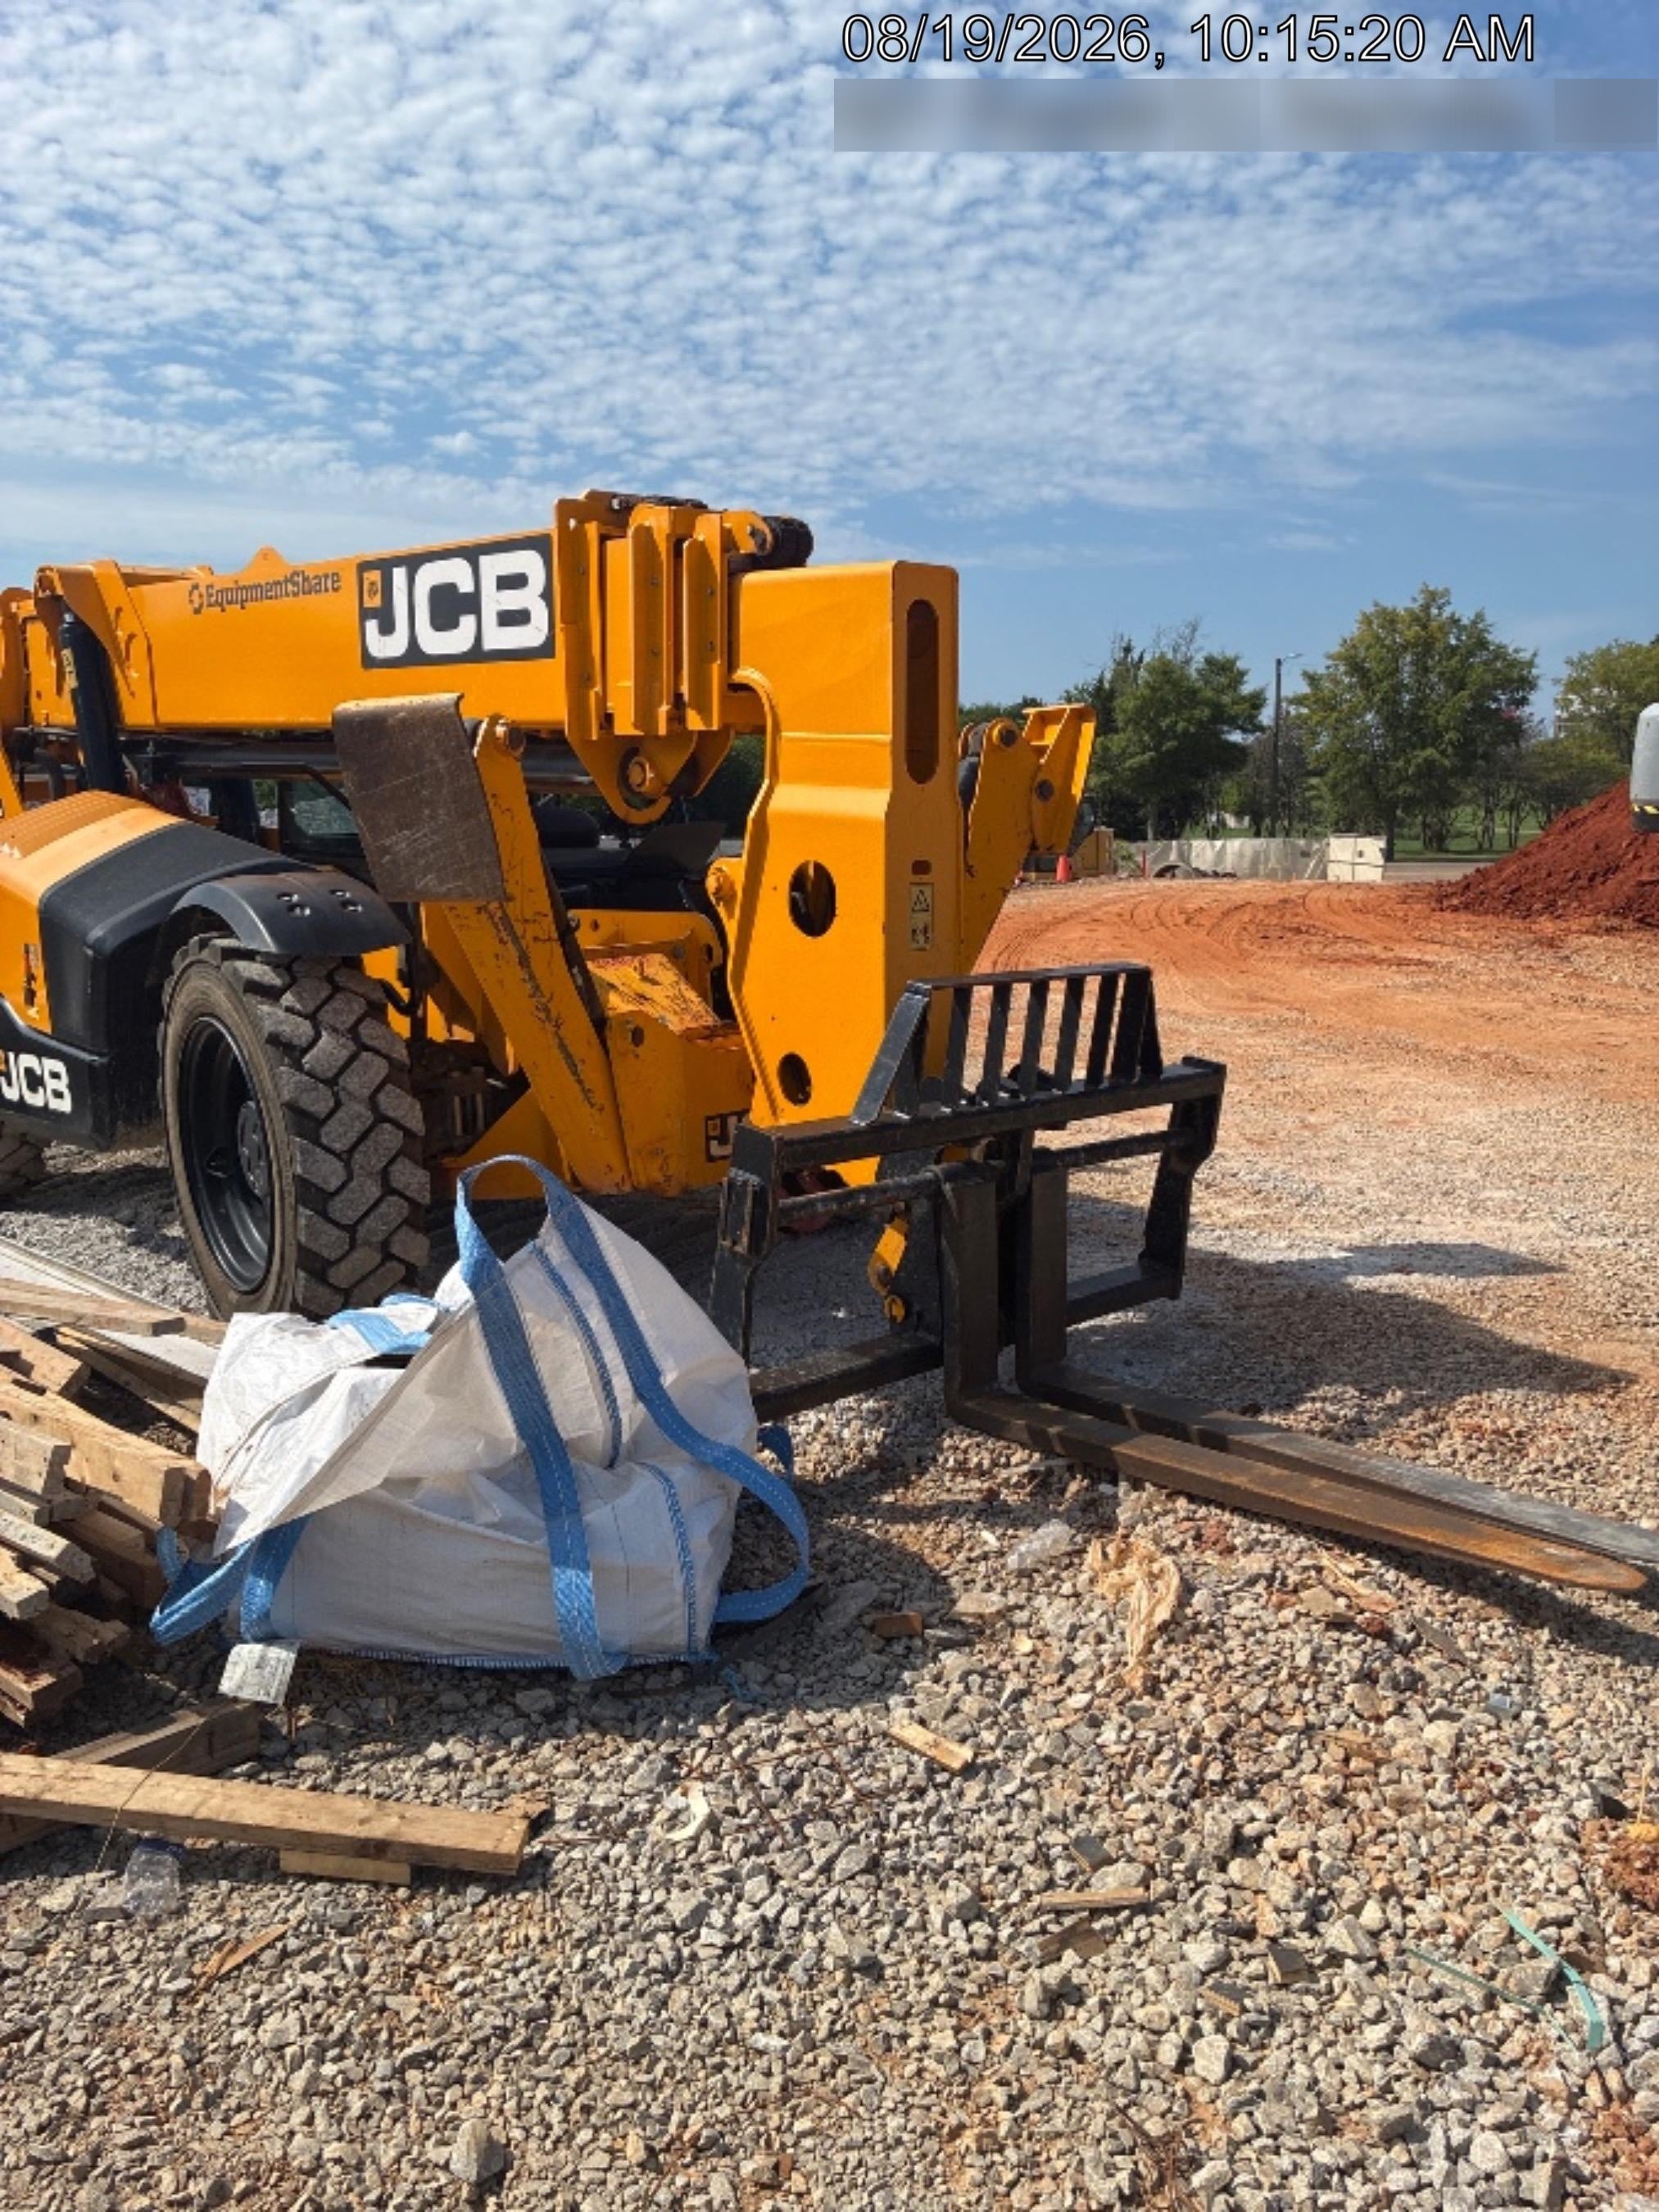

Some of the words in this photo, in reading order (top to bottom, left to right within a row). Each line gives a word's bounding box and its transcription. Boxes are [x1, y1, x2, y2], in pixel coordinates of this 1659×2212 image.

[206, 570, 342, 612] EquipmentShare
[365, 550, 549, 659] JCB
[0, 1051, 72, 1114] JCB
